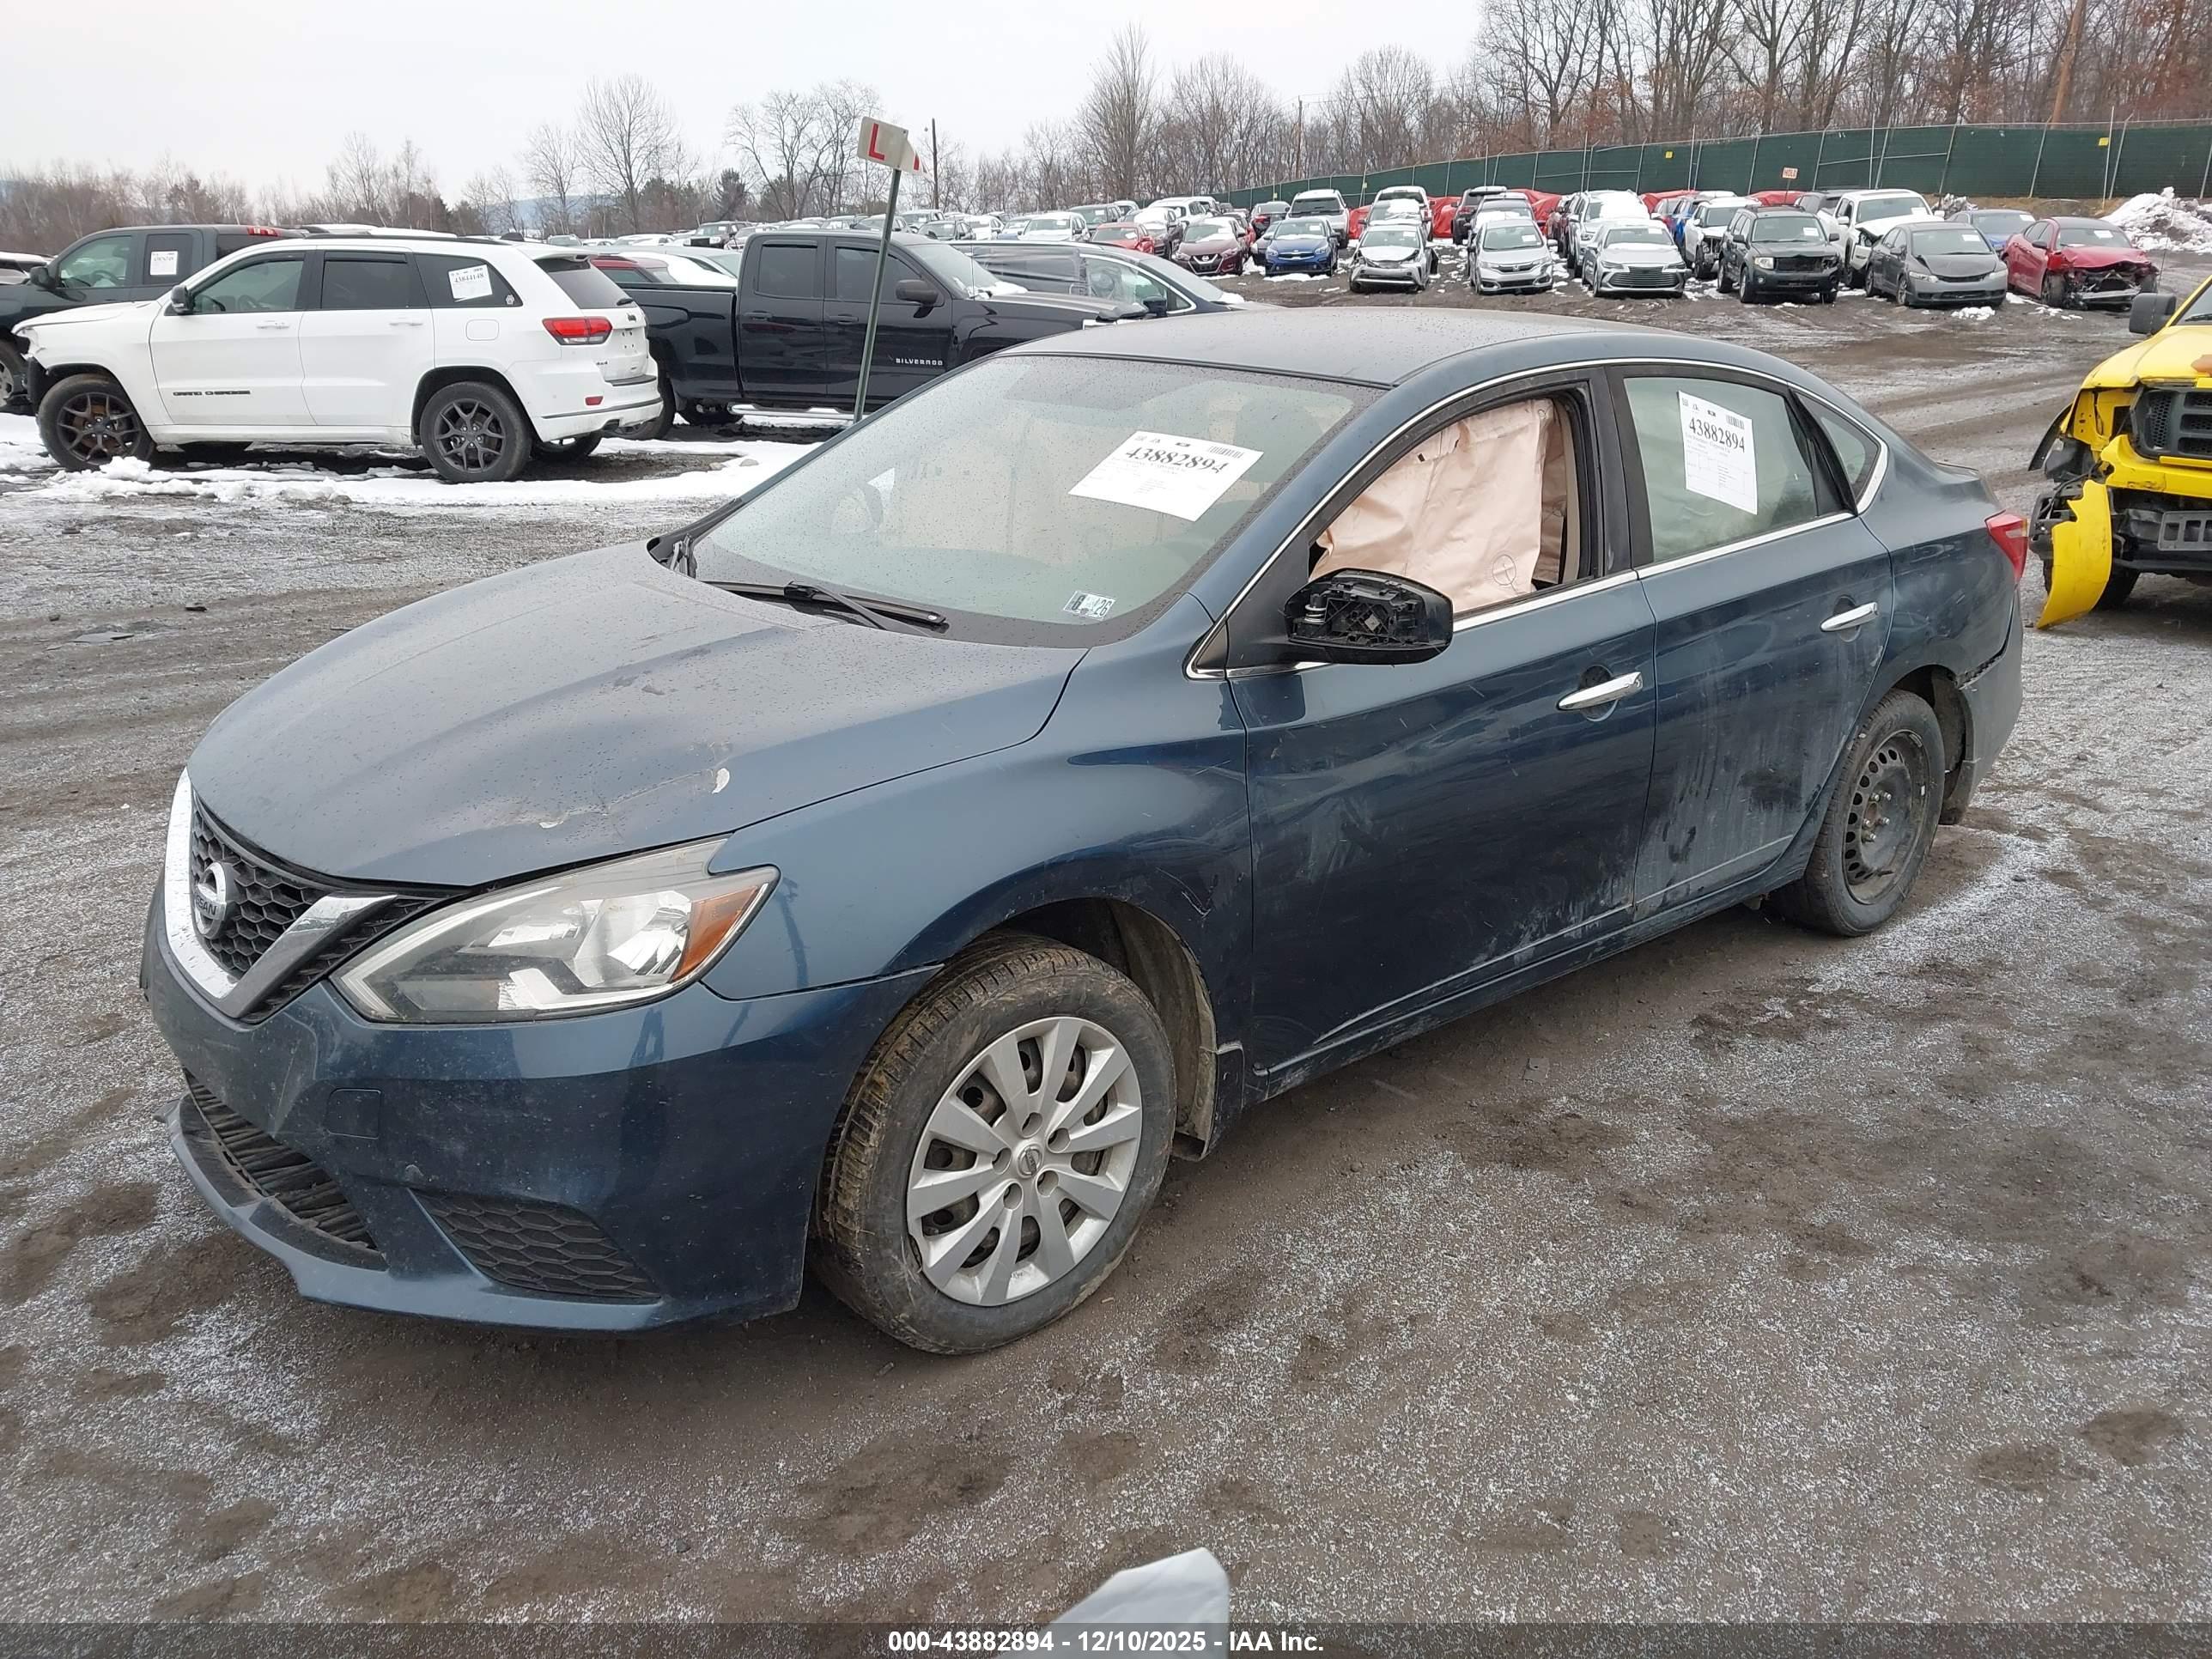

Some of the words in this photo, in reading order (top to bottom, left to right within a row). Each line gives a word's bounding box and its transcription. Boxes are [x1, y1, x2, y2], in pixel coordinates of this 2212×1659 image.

[868, 123, 885, 161] L
[895, 357, 943, 366] SILVERADO
[1689, 416, 1746, 453] 43882894
[1126, 447, 1230, 473] 43882894
[1093, 599, 1113, 617] 26
